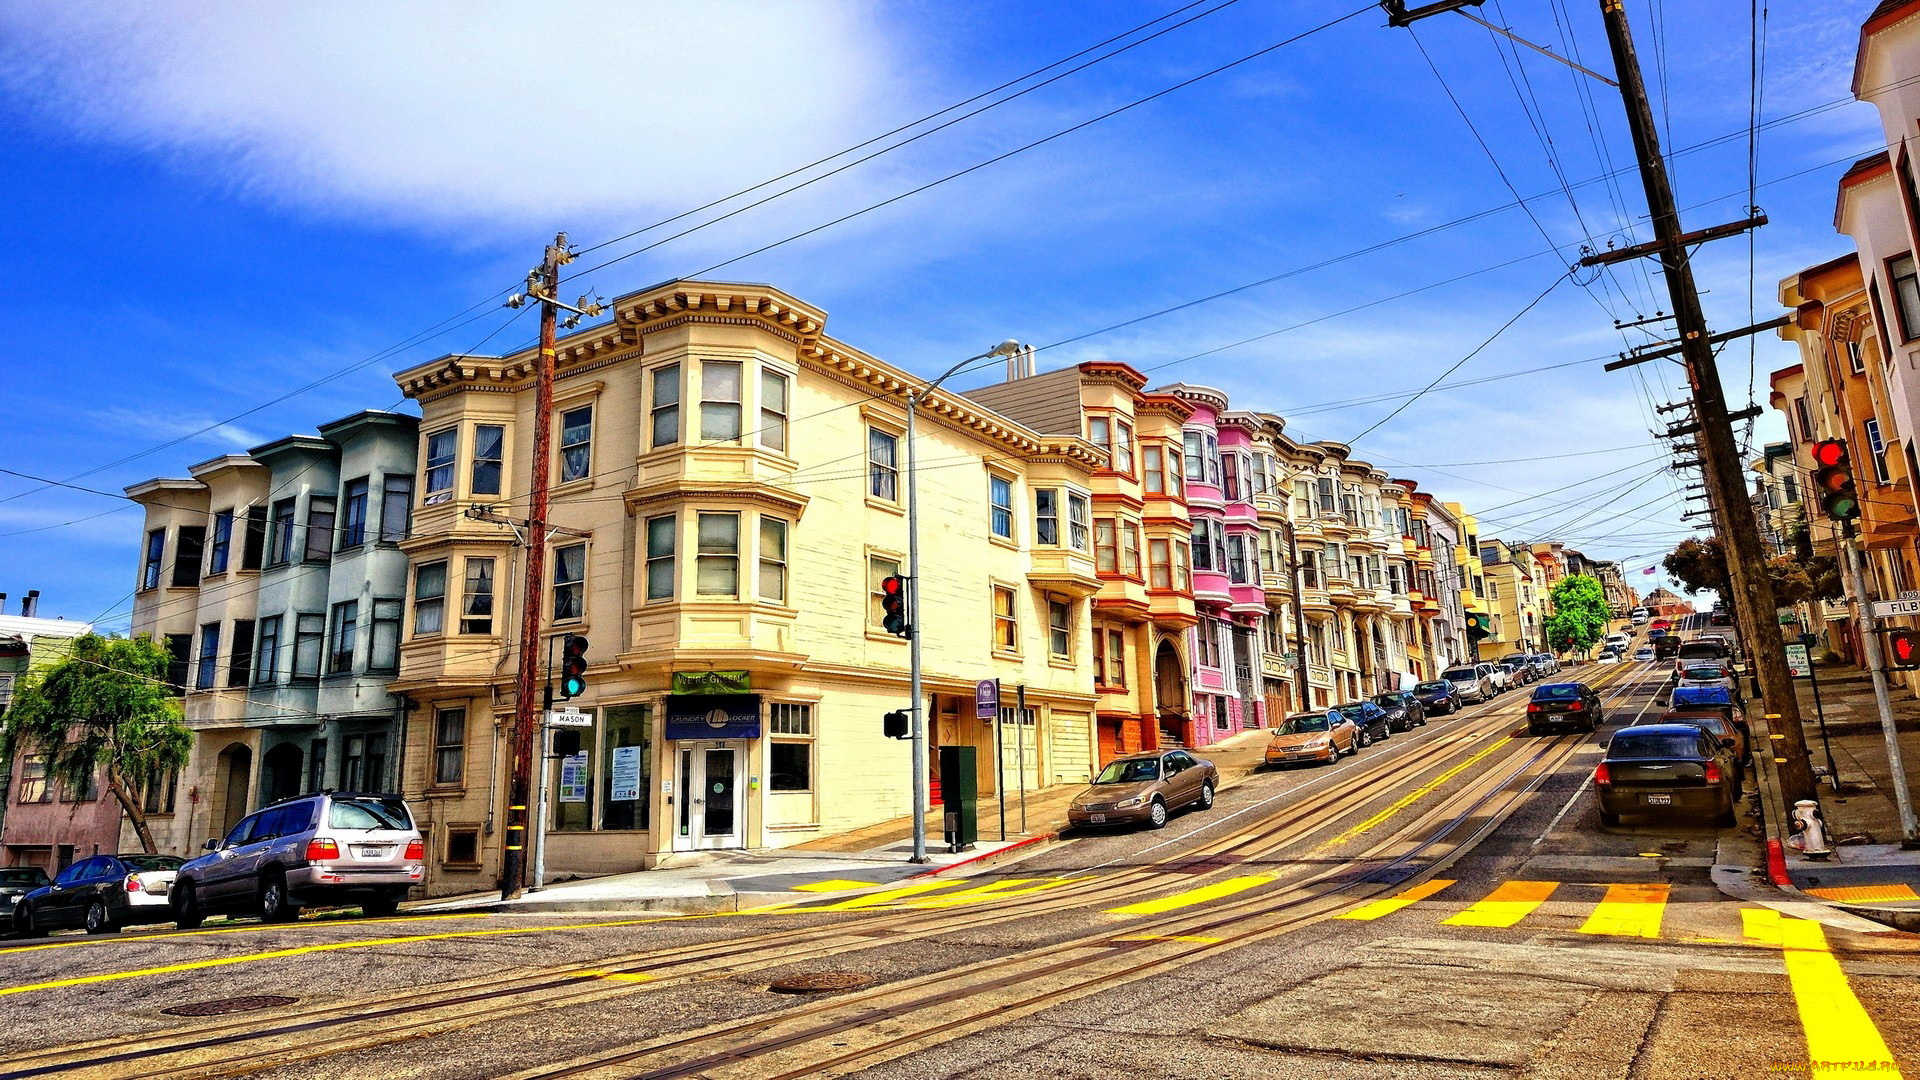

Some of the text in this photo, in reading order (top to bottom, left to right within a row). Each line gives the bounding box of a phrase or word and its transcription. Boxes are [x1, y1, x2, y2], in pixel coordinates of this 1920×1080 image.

[1891, 602, 1920, 612] FILB
[677, 674, 744, 684] WE'RE GREEN!
